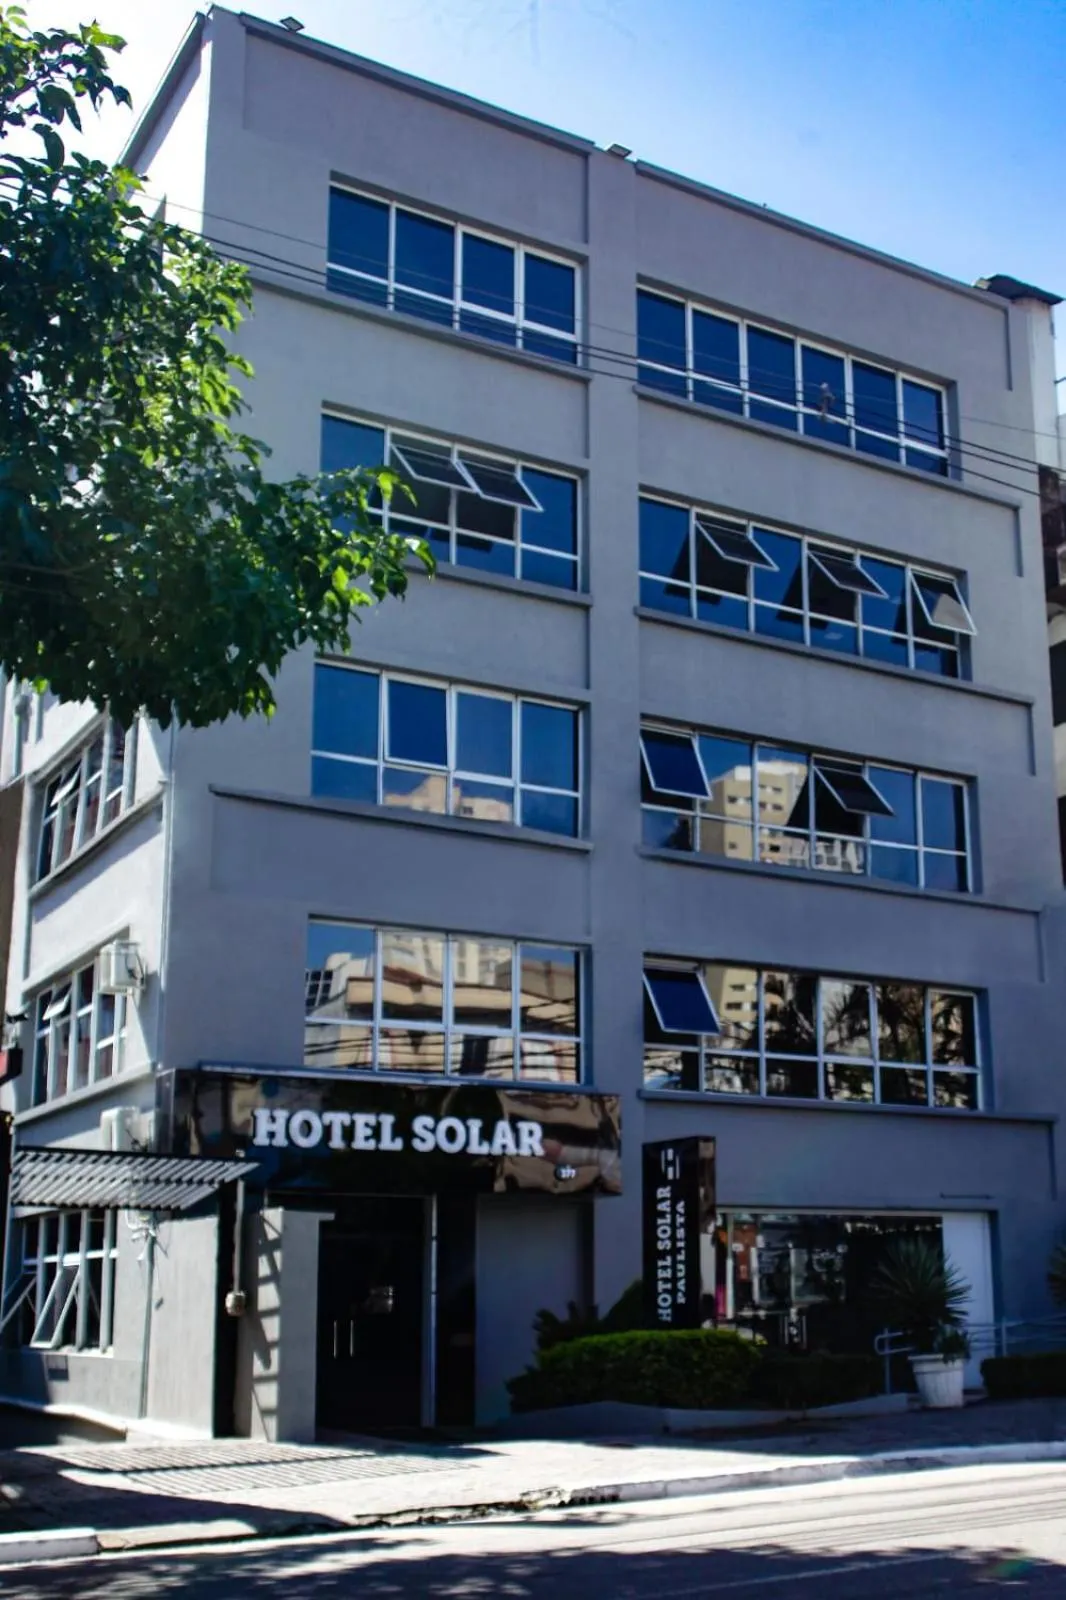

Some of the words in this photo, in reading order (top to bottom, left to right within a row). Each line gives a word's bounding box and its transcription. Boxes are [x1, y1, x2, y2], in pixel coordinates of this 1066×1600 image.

[253, 1109, 403, 1151] HOTEL
[411, 1115, 545, 1156] SOLAR
[656, 1185, 672, 1250] SOLAR
[676, 1200, 686, 1304] PAULISTA
[657, 1256, 672, 1321] HOTEL
